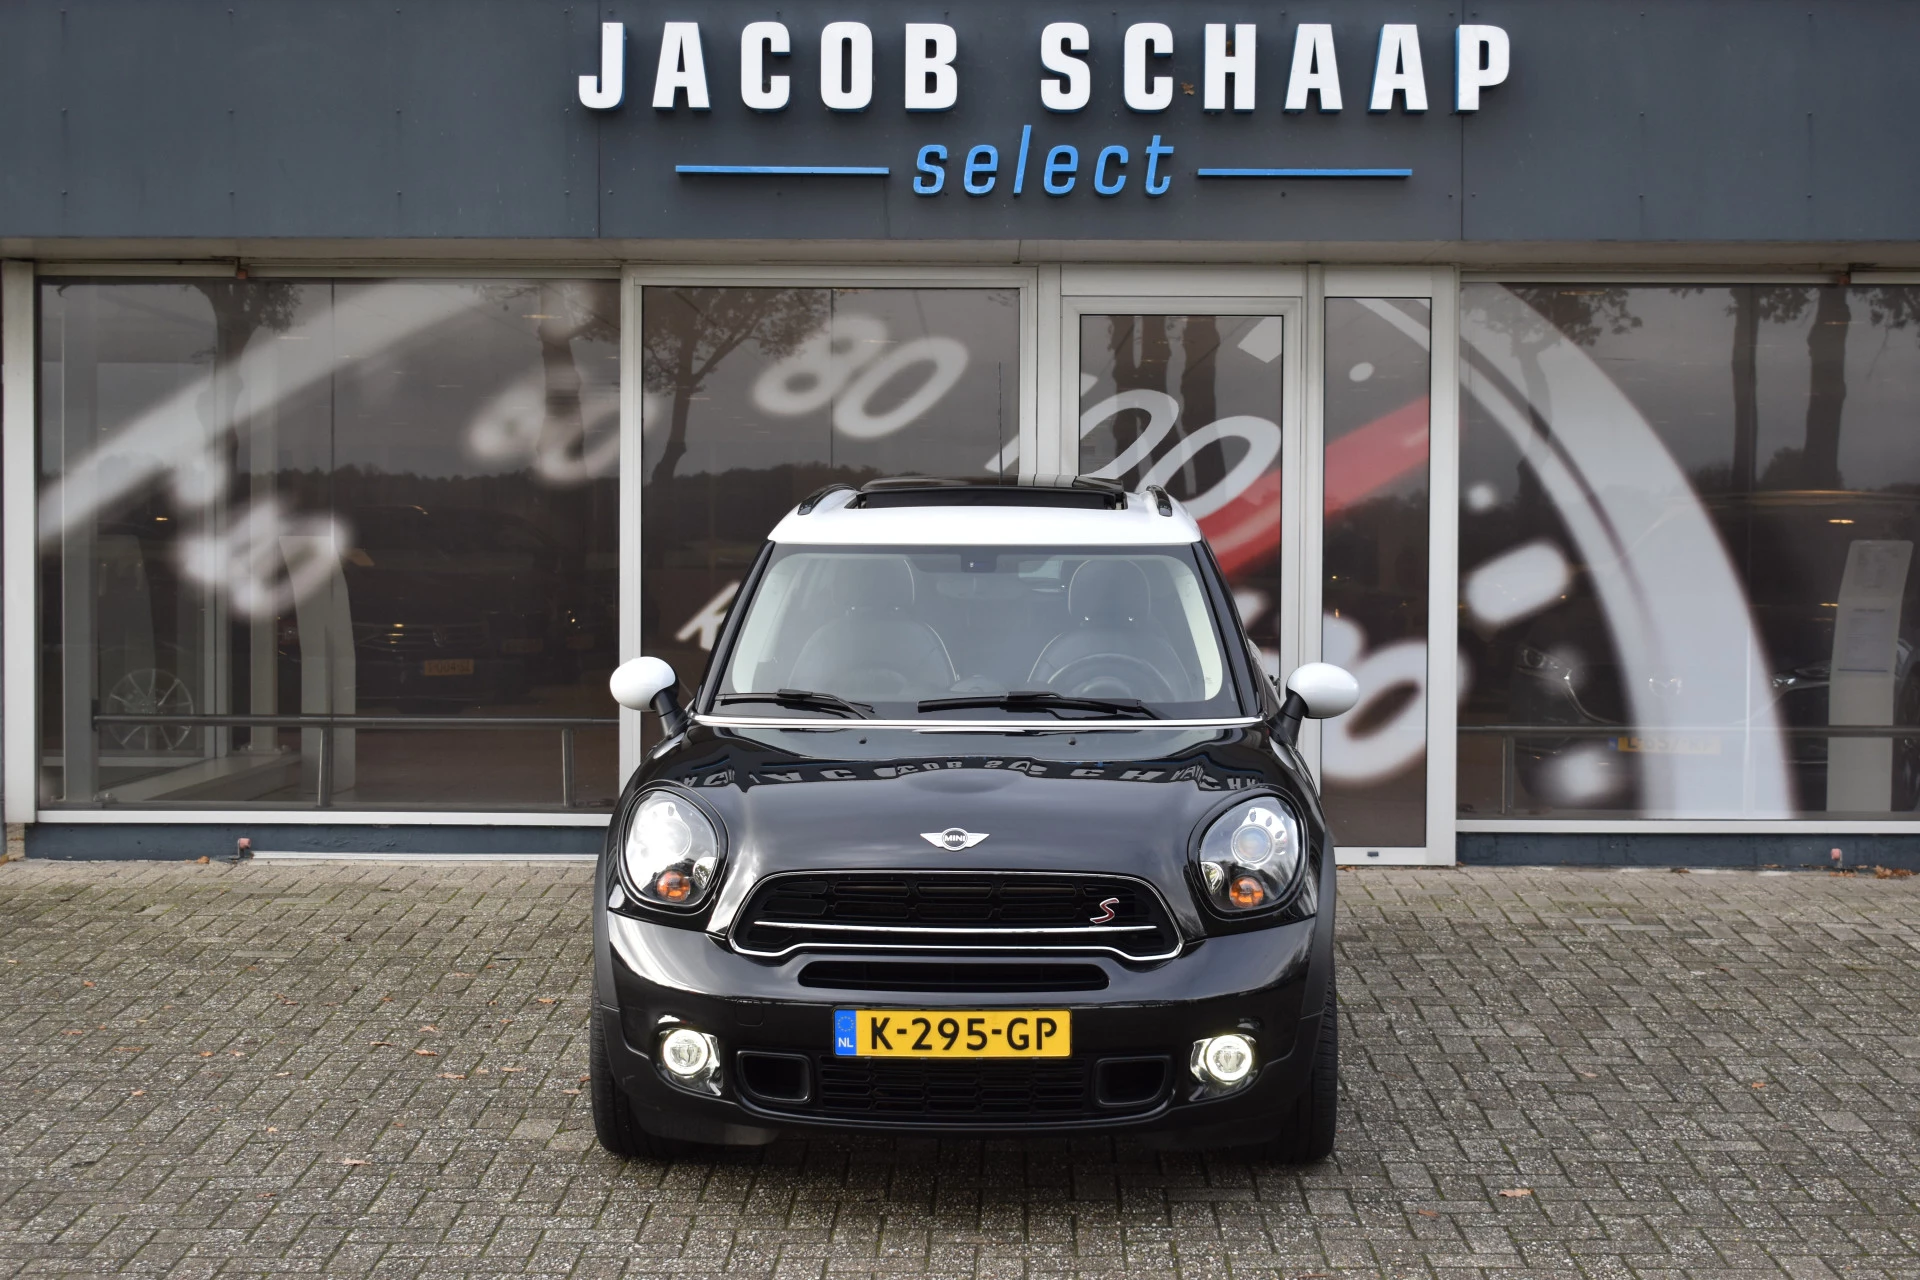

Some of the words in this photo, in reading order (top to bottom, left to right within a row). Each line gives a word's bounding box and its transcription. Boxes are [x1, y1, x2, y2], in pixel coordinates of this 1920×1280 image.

[579, 22, 958, 111] JACOB
[1040, 22, 1510, 113] SCHAAP
[912, 124, 1175, 196] select
[754, 314, 970, 438] 80
[944, 834, 966, 842] MINI
[1090, 898, 1119, 924] S
[838, 1037, 854, 1049] NL
[871, 1017, 1058, 1051] K-295-GP
